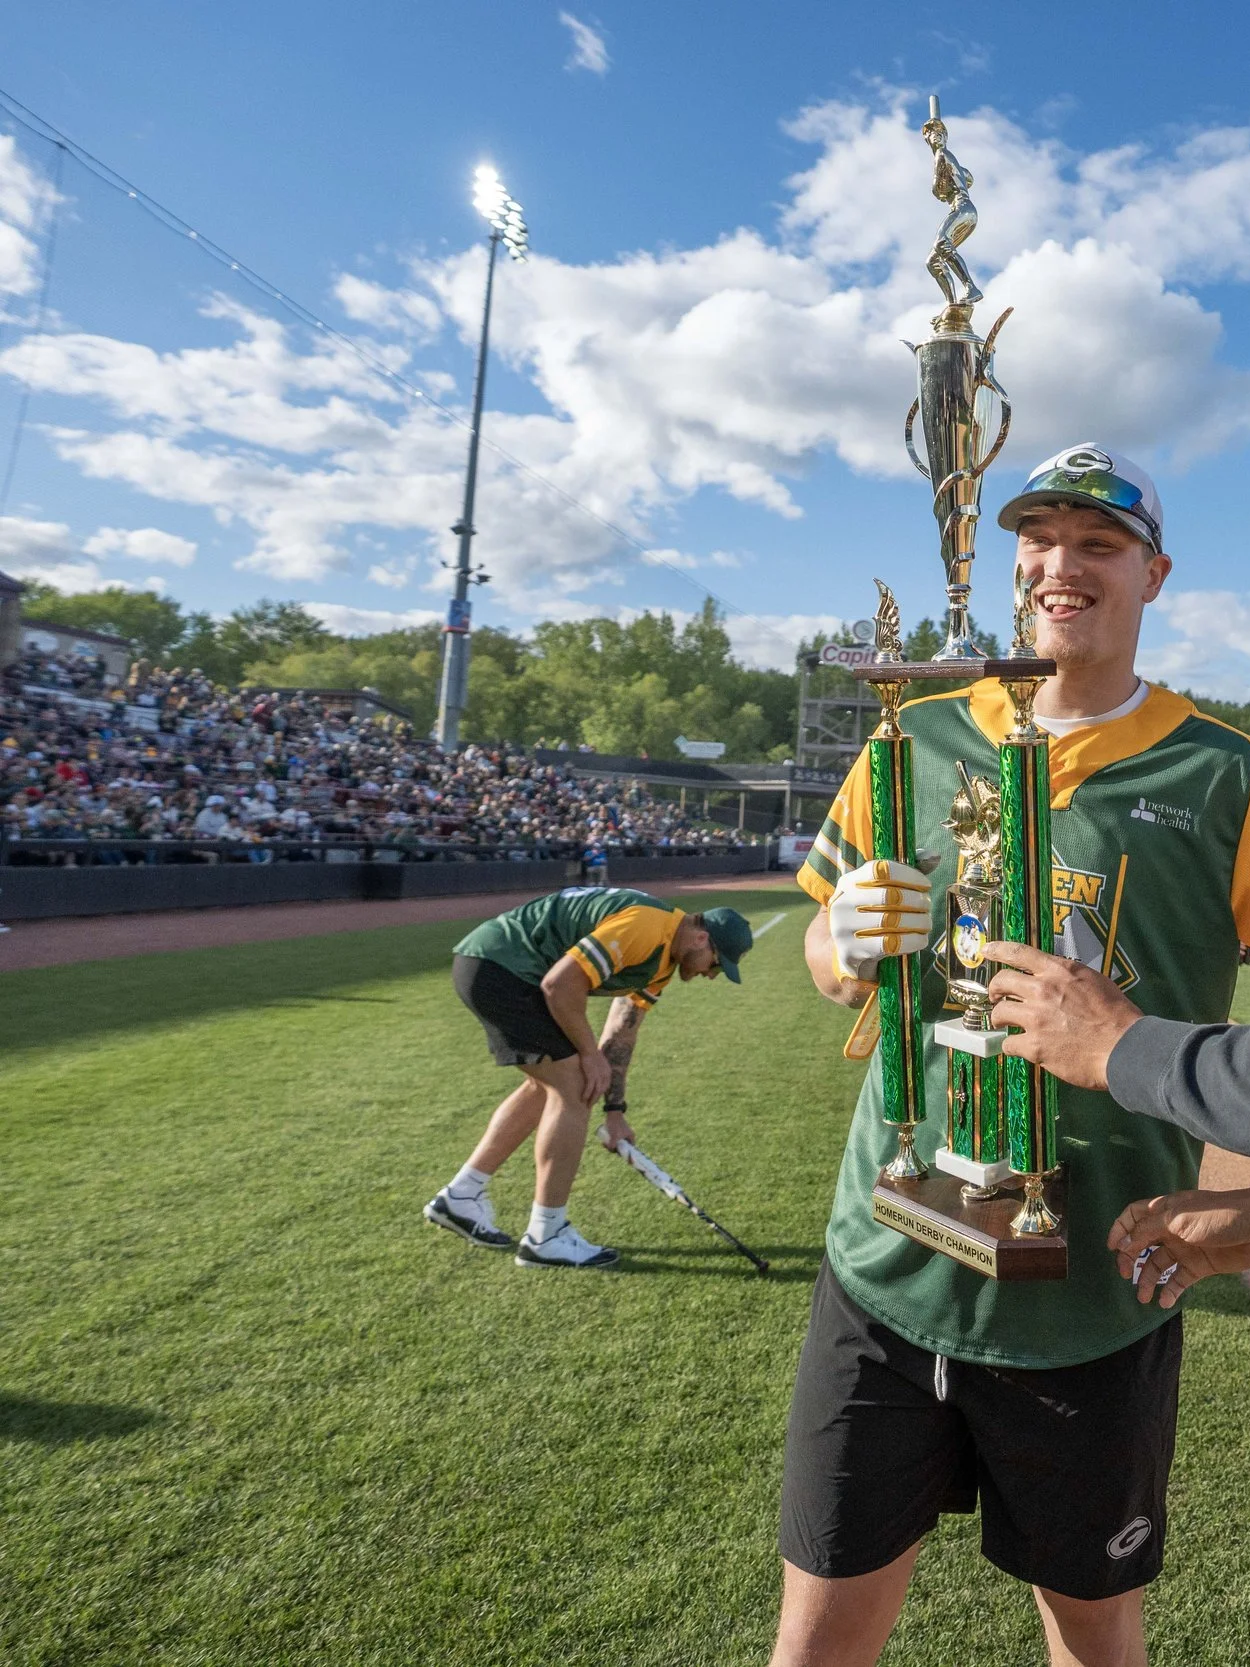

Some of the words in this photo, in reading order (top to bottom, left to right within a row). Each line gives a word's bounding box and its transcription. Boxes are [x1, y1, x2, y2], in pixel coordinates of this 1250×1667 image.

[823, 645, 877, 667] Capit
[1148, 801, 1192, 819] network
[1156, 813, 1190, 831] health
[875, 1202, 915, 1230] HOMERUN
[916, 1221, 945, 1243] DERBY
[945, 1236, 993, 1267] CHAMPION
